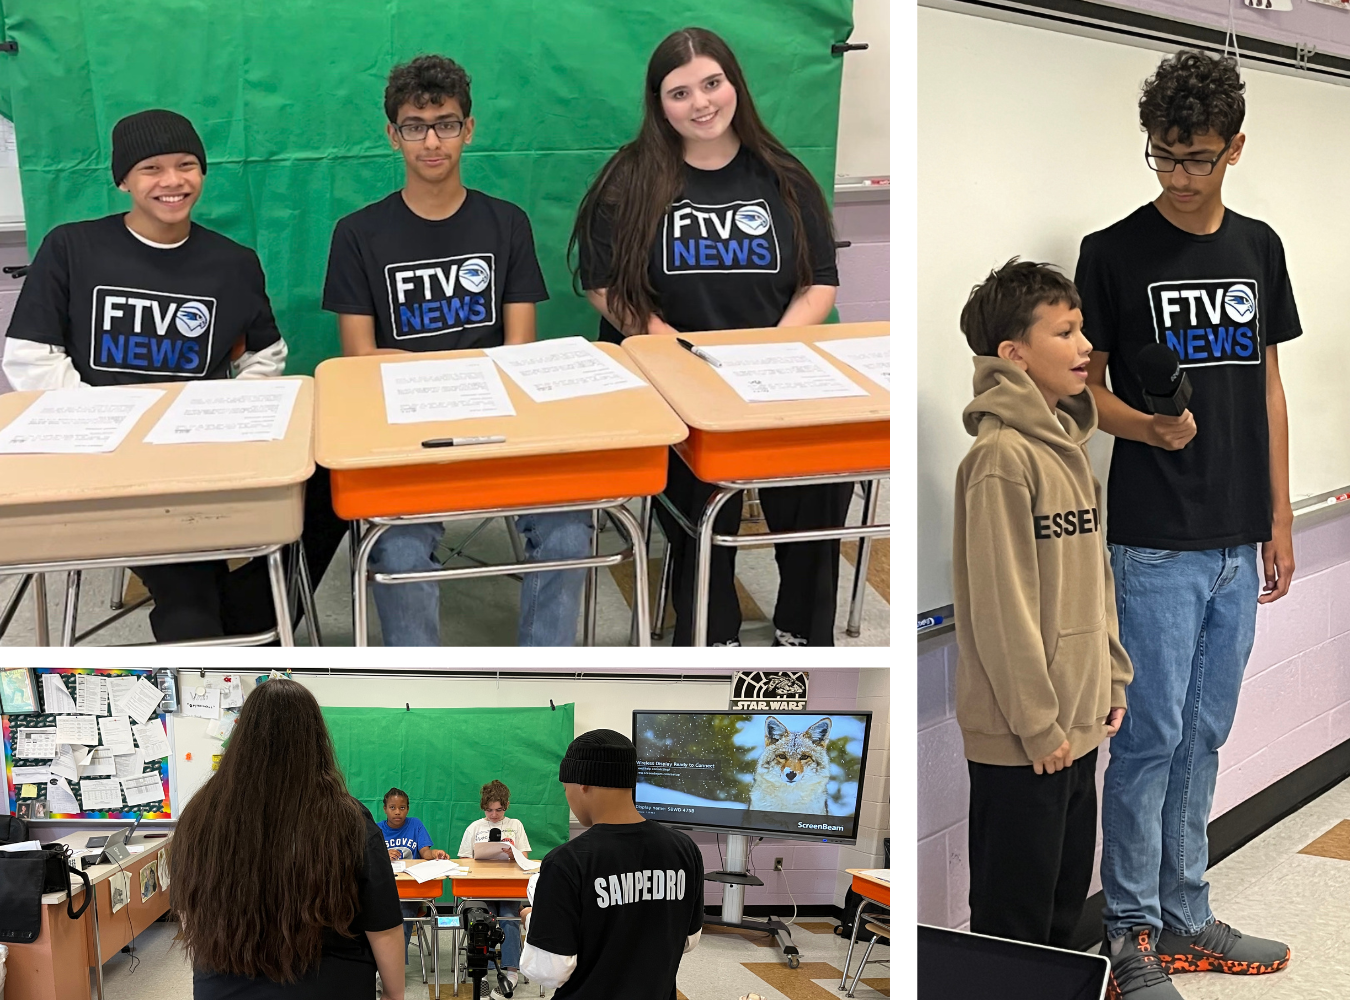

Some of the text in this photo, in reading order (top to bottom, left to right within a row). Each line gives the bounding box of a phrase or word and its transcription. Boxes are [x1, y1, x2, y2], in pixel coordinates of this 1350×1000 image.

[673, 208, 733, 239] FTV
[674, 239, 771, 266] NEWS
[395, 265, 458, 303] FTV
[103, 296, 177, 335] FTV
[400, 295, 486, 332] NEWS
[1161, 289, 1224, 327] FTV
[101, 334, 199, 369] NEWS
[1166, 327, 1253, 360] NEWS
[733, 701, 806, 710] STAR WARS
[797, 821, 844, 831] ScreenBeam
[594, 869, 686, 908] SAMPEDRO
